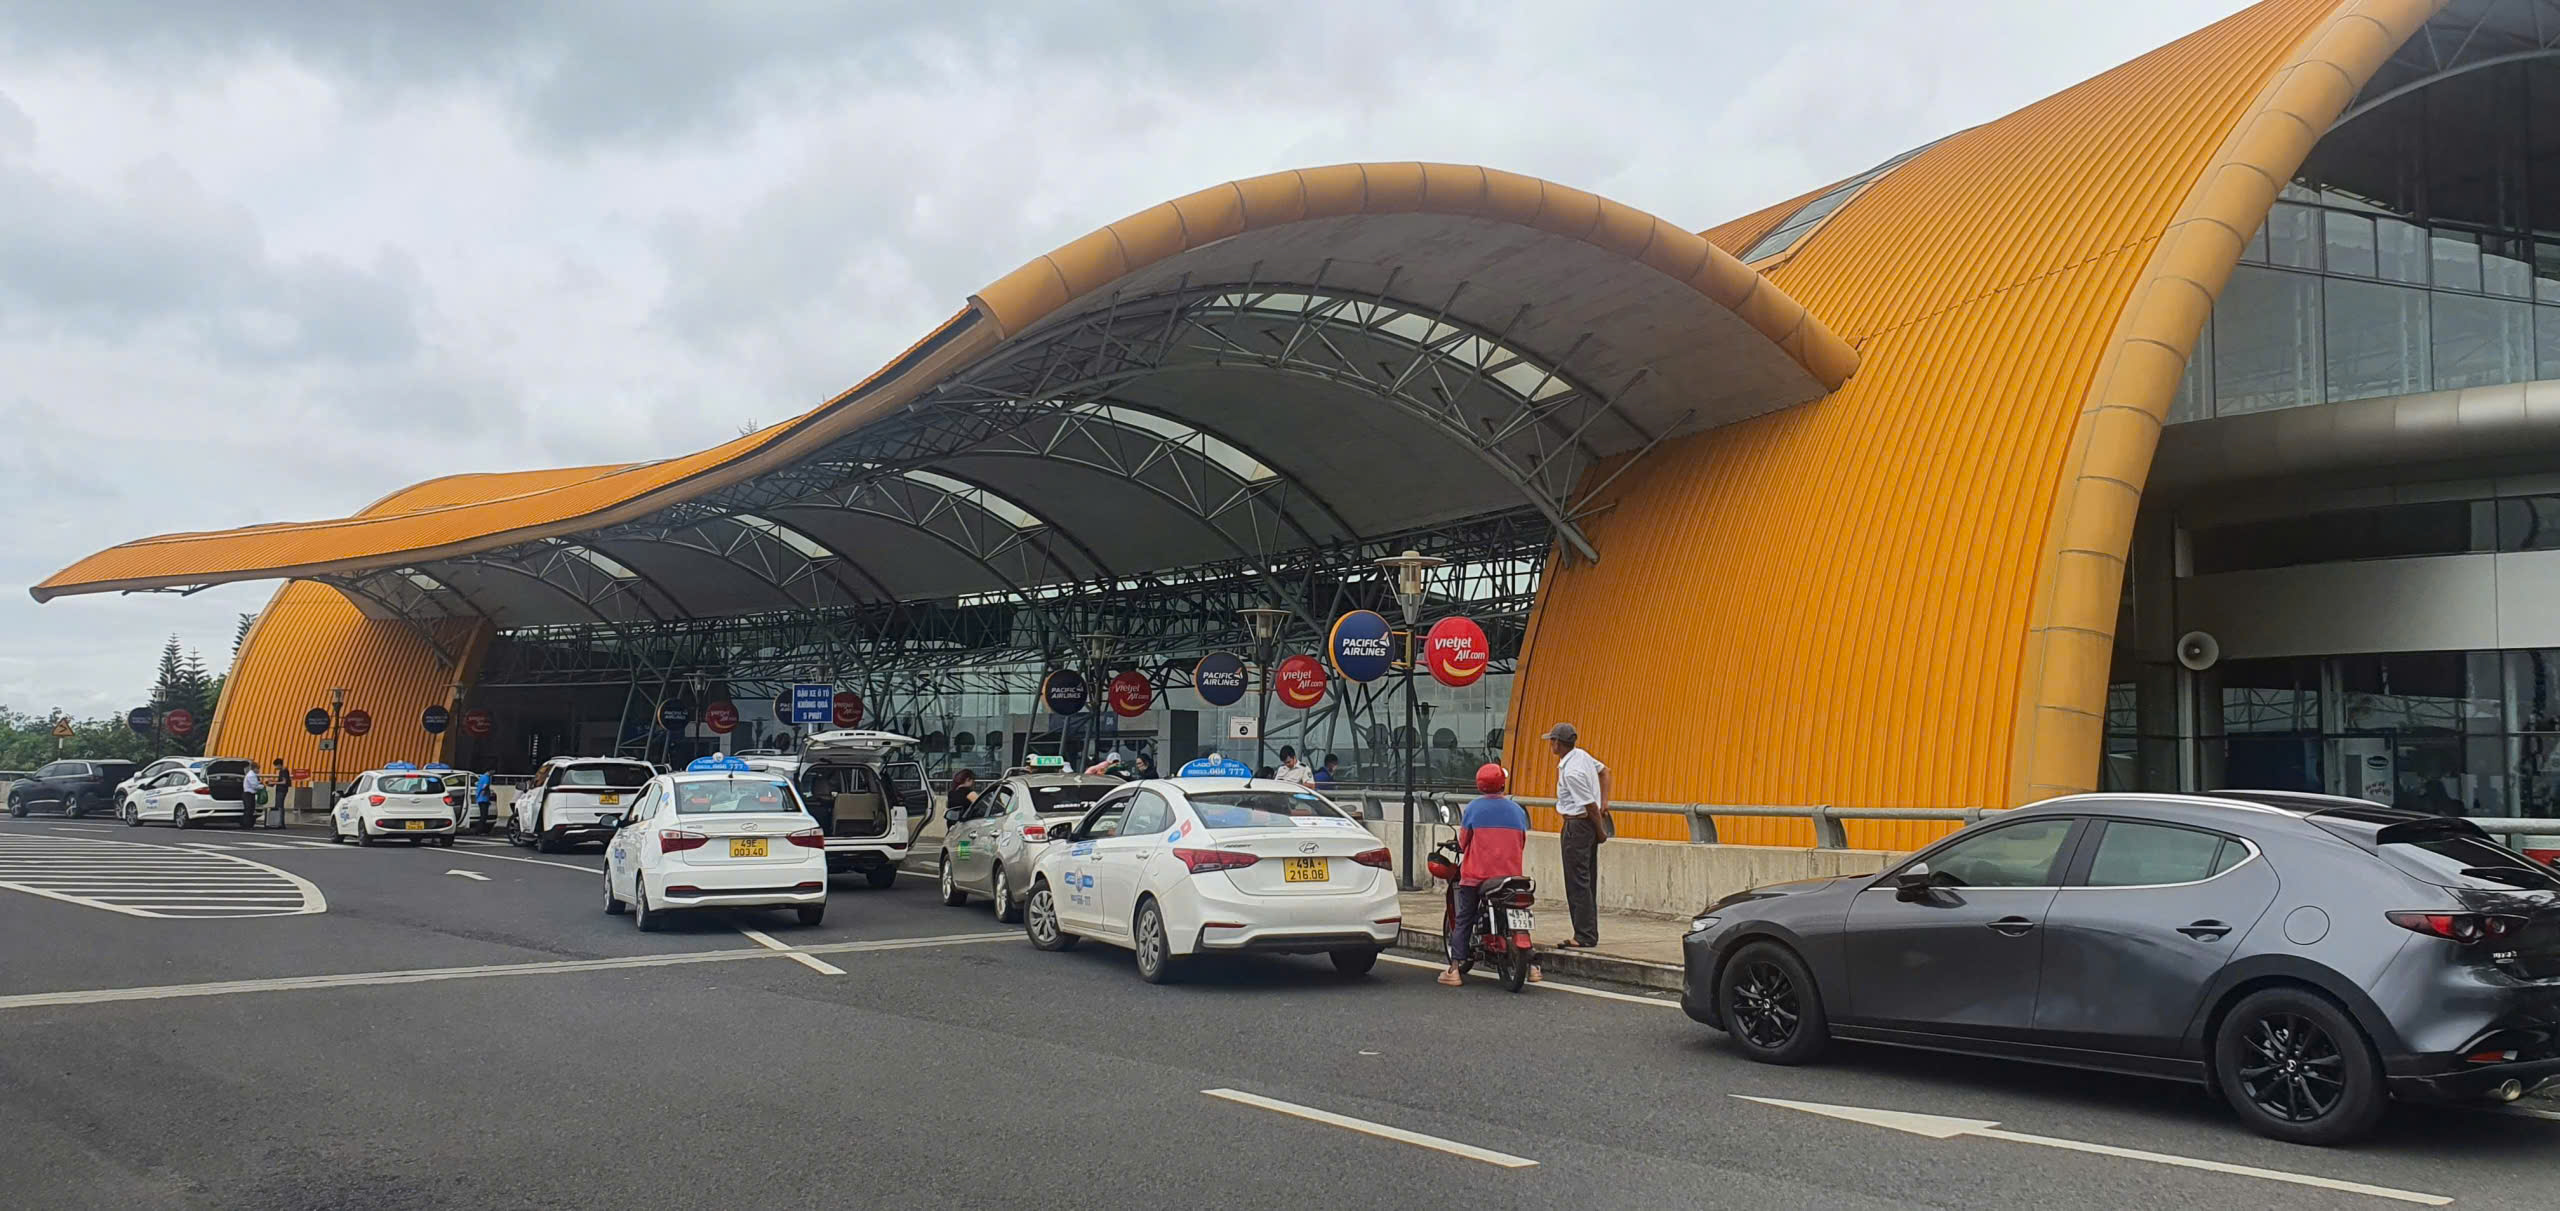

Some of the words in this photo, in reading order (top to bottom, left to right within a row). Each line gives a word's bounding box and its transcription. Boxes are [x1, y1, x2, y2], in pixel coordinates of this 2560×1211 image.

[1343, 639, 1379, 647] PACIFIC
[1435, 637, 1472, 651] Vietjet
[1343, 648, 1386, 656] AIRLINES
[1282, 670, 1311, 682] Vietjet
[809, 689, 817, 697] XE
[1297, 858, 1315, 869] 49A
[1290, 870, 1324, 880] 216.08
